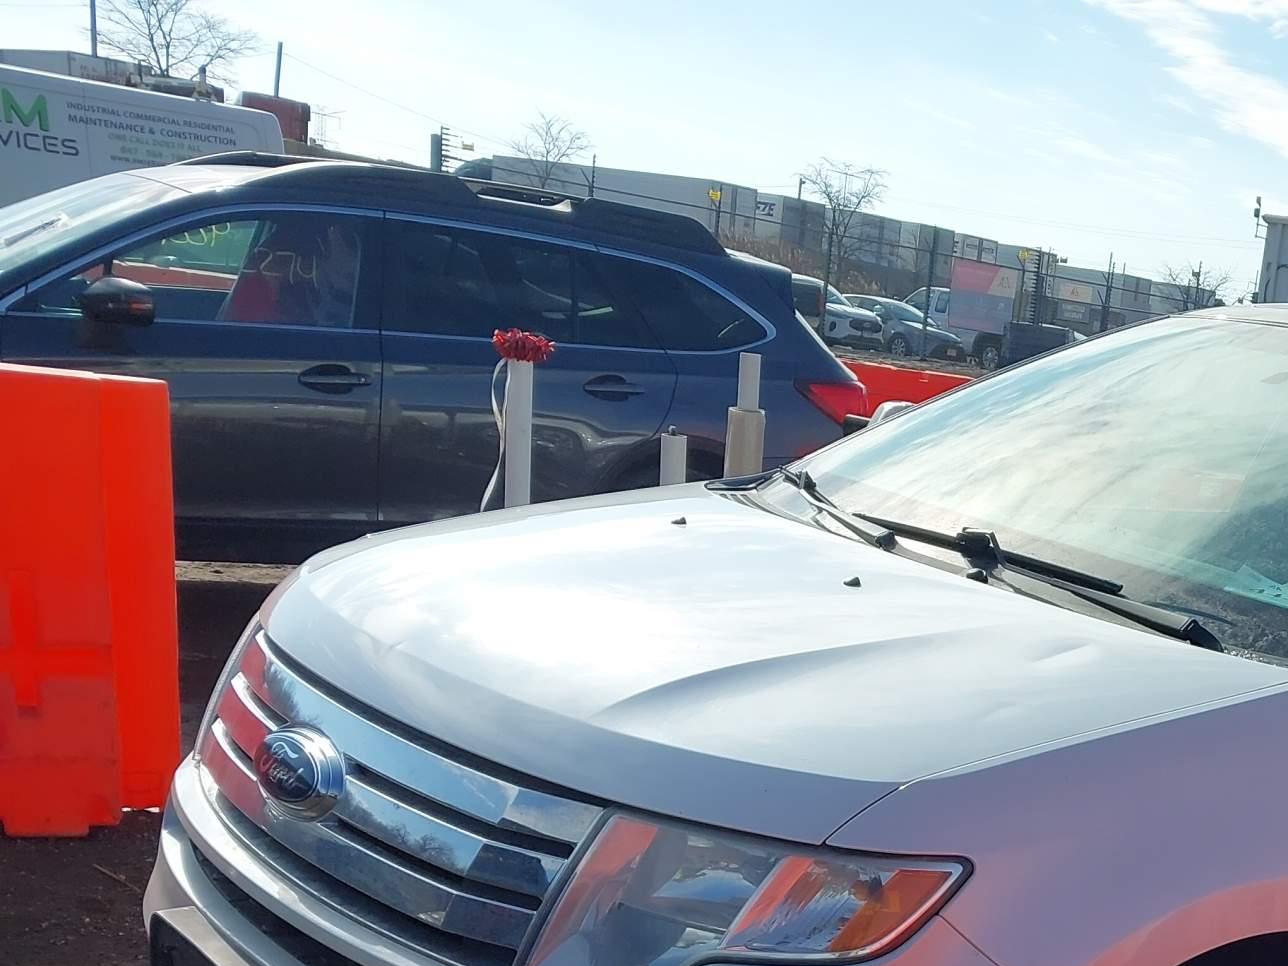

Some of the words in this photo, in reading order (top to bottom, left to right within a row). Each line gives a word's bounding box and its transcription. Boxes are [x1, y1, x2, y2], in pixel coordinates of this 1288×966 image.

[66, 102, 121, 117] INDUSTRIAL
[123, 110, 181, 126] COMMERCIAL
[183, 119, 235, 134] RESIDENTIAL
[68, 113, 145, 134] MAINTENANCE
[148, 127, 156, 135] &
[160, 128, 237, 147] CONSTRUCTION
